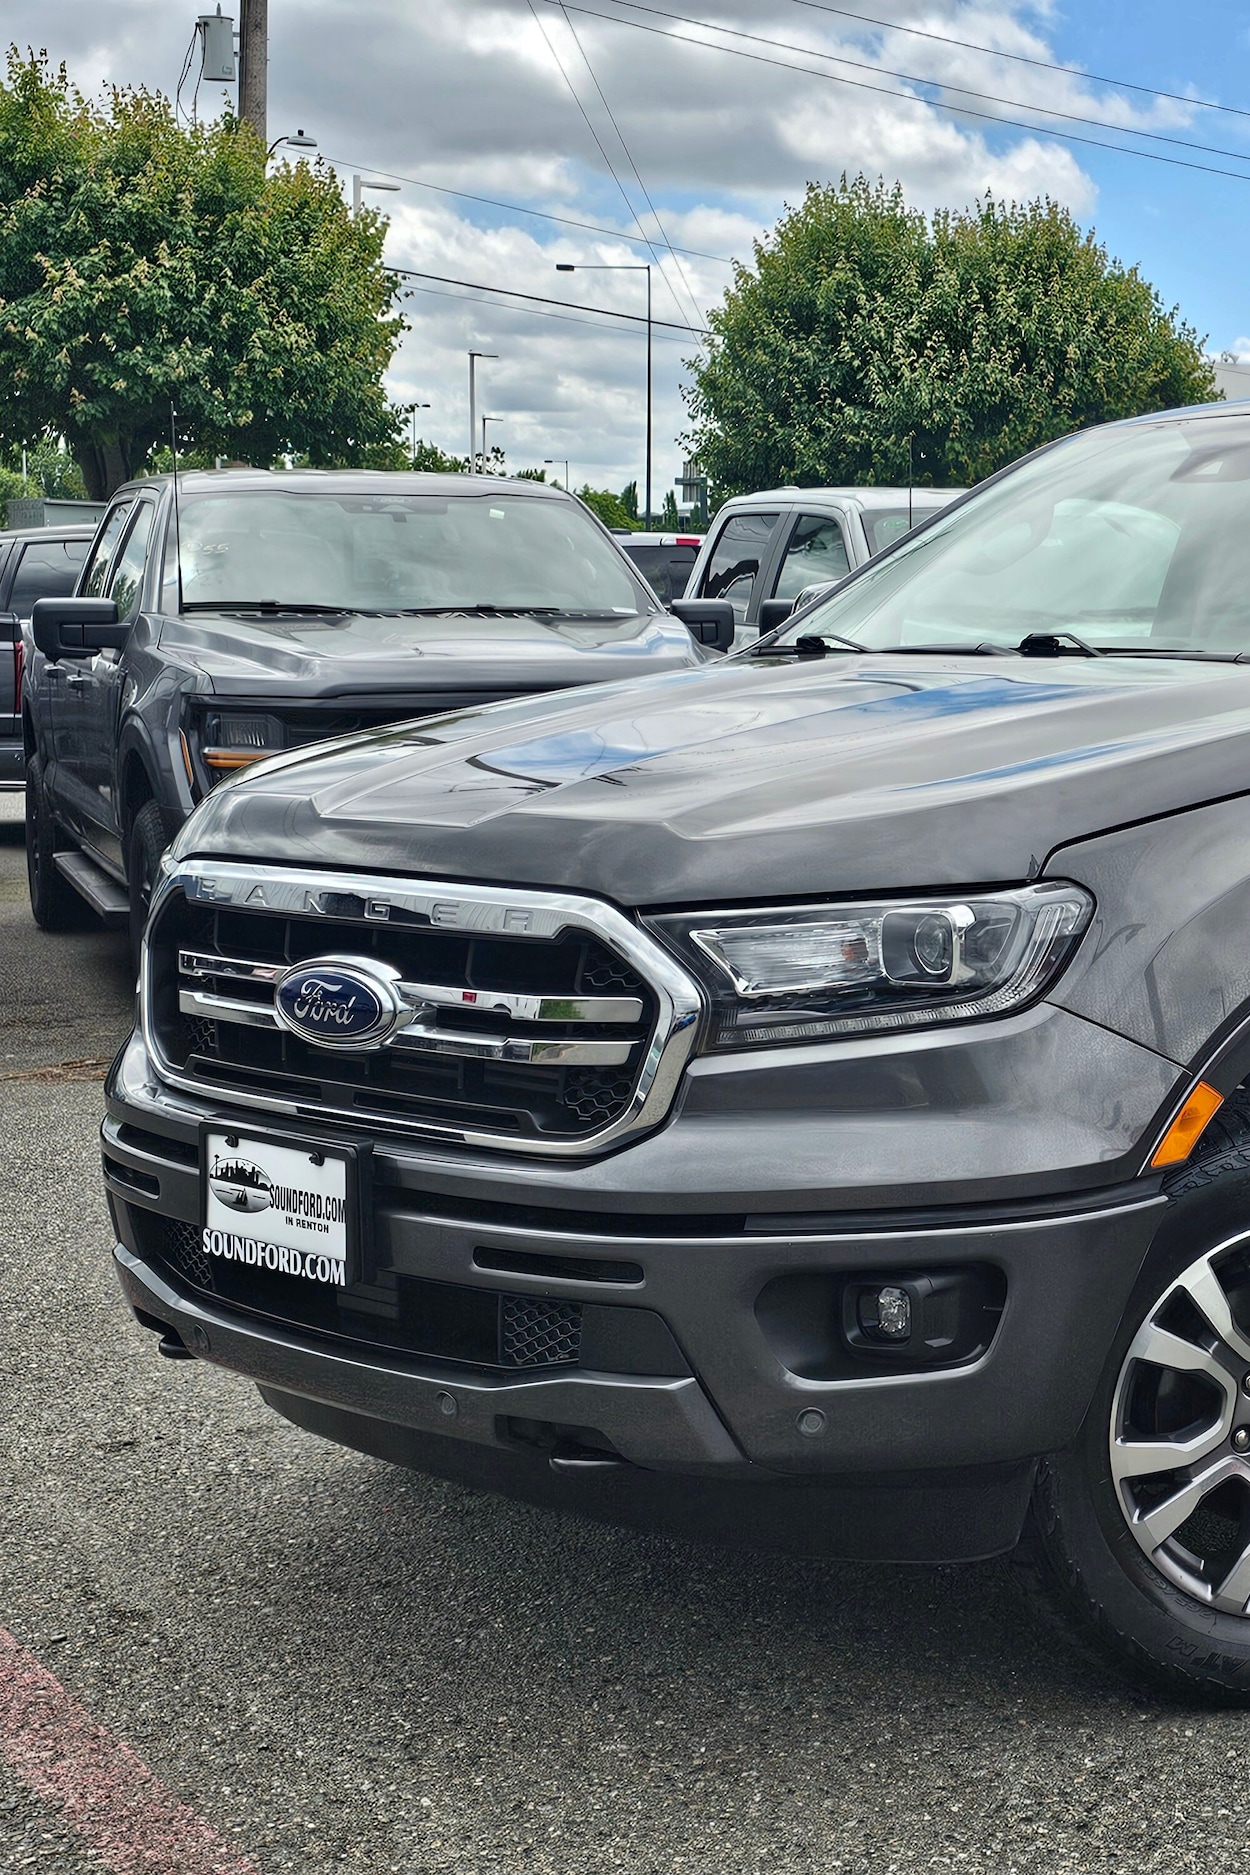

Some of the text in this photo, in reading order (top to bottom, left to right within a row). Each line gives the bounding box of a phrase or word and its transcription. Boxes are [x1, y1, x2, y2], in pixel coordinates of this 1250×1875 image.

[197, 877, 534, 933] RANGER
[292, 978, 357, 1026] Ford
[269, 1183, 347, 1224] SOUNDFORD.COM
[285, 1216, 330, 1234] IN RENTON
[202, 1227, 346, 1287] SOUNDFORD.COM
